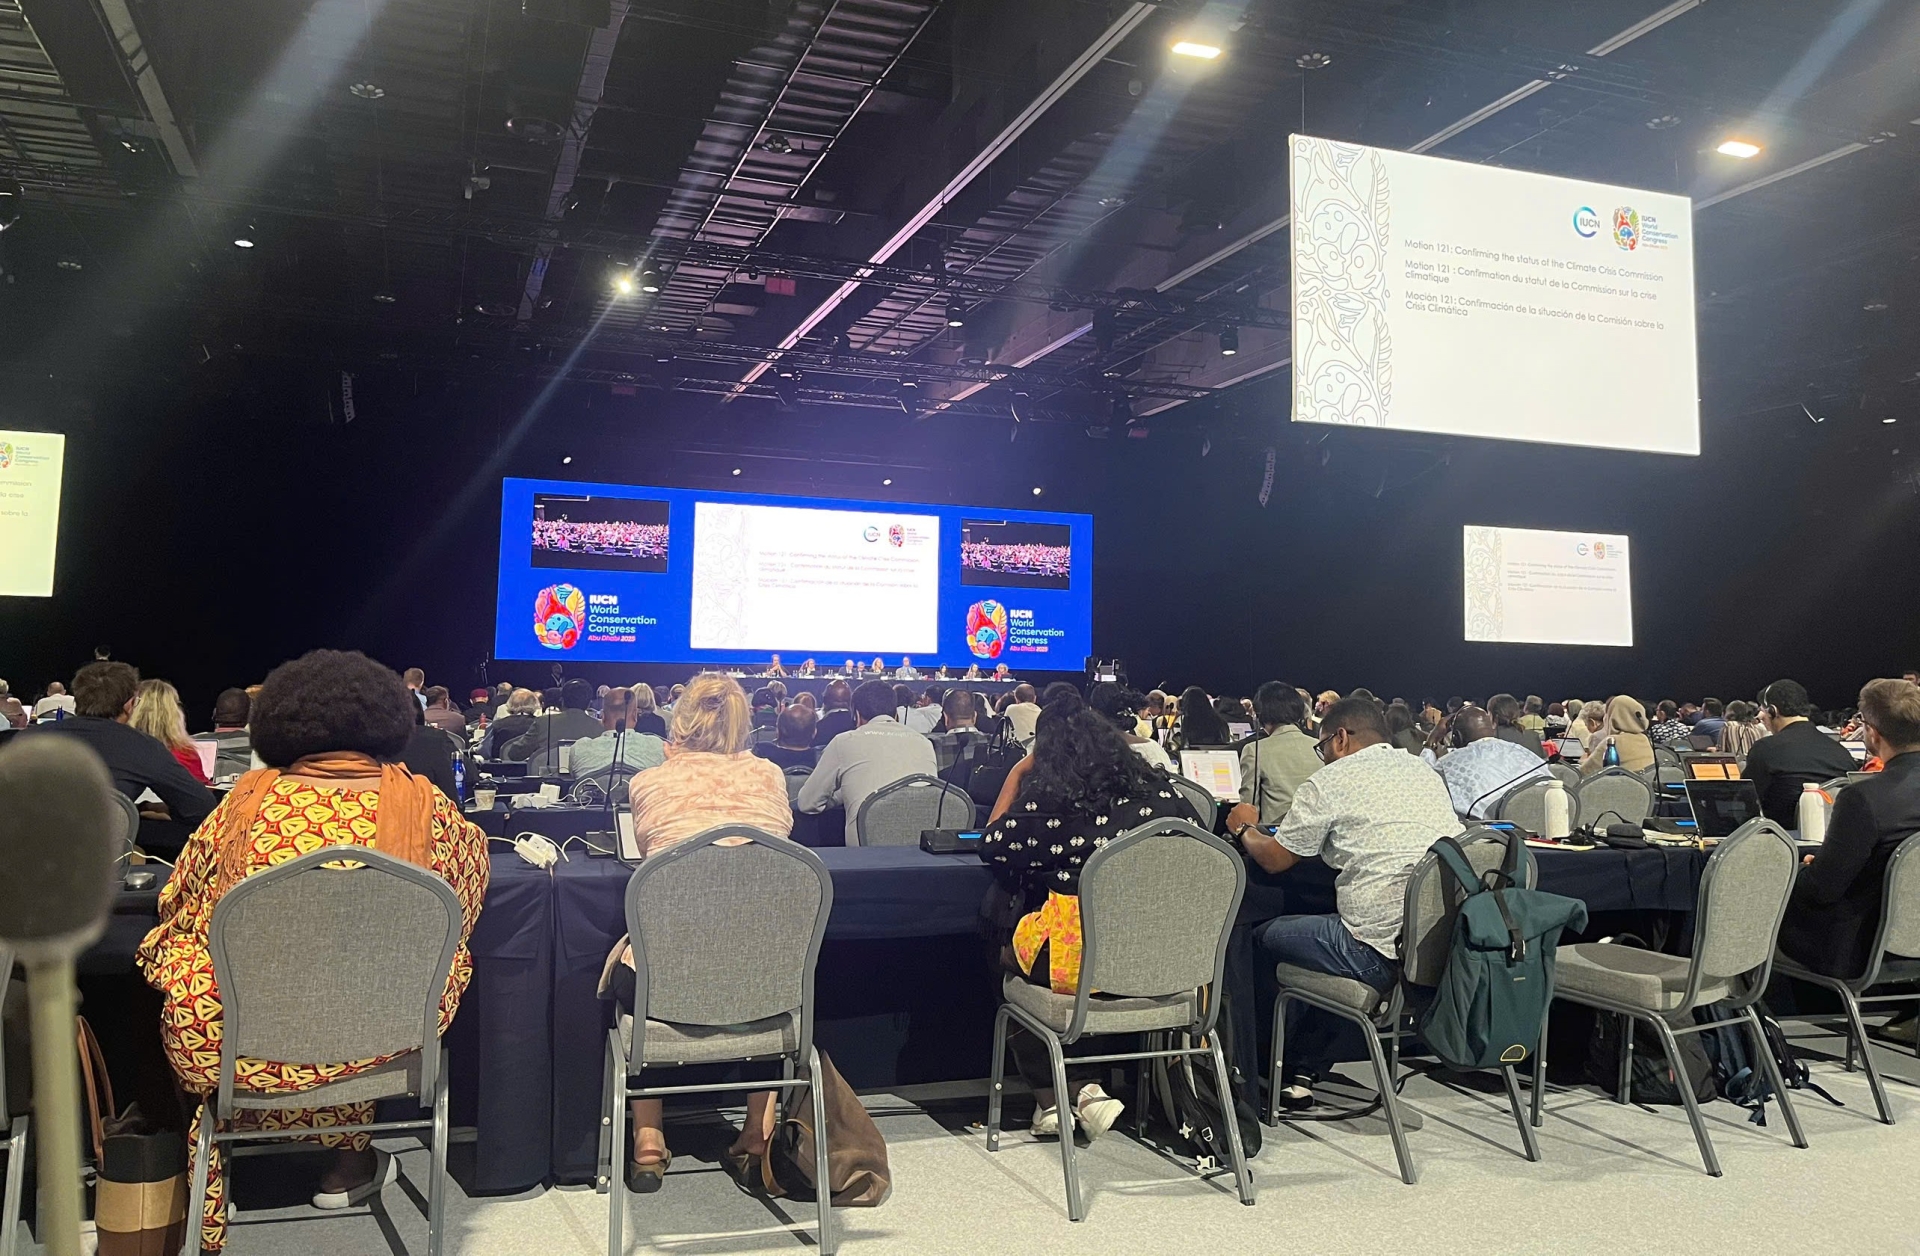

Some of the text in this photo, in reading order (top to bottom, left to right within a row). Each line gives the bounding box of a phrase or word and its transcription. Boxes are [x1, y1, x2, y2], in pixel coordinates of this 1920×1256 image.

[1580, 218, 1600, 228] IUCN
[1642, 229, 1678, 239] Conservation
[1642, 236, 1667, 244] Congress
[1405, 240, 1663, 282] Motion 121: Confirming the status of the Climate Crisis Commission
[1405, 270, 1450, 284] climatique
[1406, 260, 1434, 271] Motion
[1438, 263, 1450, 273] 121
[1458, 266, 1510, 281] Confirmation
[1512, 274, 1523, 283] du
[1525, 277, 1546, 286] statut
[1549, 279, 1560, 288] de
[1562, 280, 1569, 289] la
[1571, 282, 1617, 295] Commission
[1630, 289, 1638, 298] la
[1640, 291, 1657, 300] crise
[1406, 300, 1468, 316] Crisis Climática
[1406, 290, 1664, 330] Moción 121: Confirmación de la situación de la Comisión sobre la
[589, 595, 618, 605] IUCN
[590, 605, 619, 614] World
[1010, 610, 1033, 619] IUCN
[588, 614, 657, 624] Conservation
[1010, 619, 1034, 627] World
[588, 624, 636, 635] Congress
[1010, 627, 1064, 637] Conservation
[1010, 636, 1048, 646] Congress
